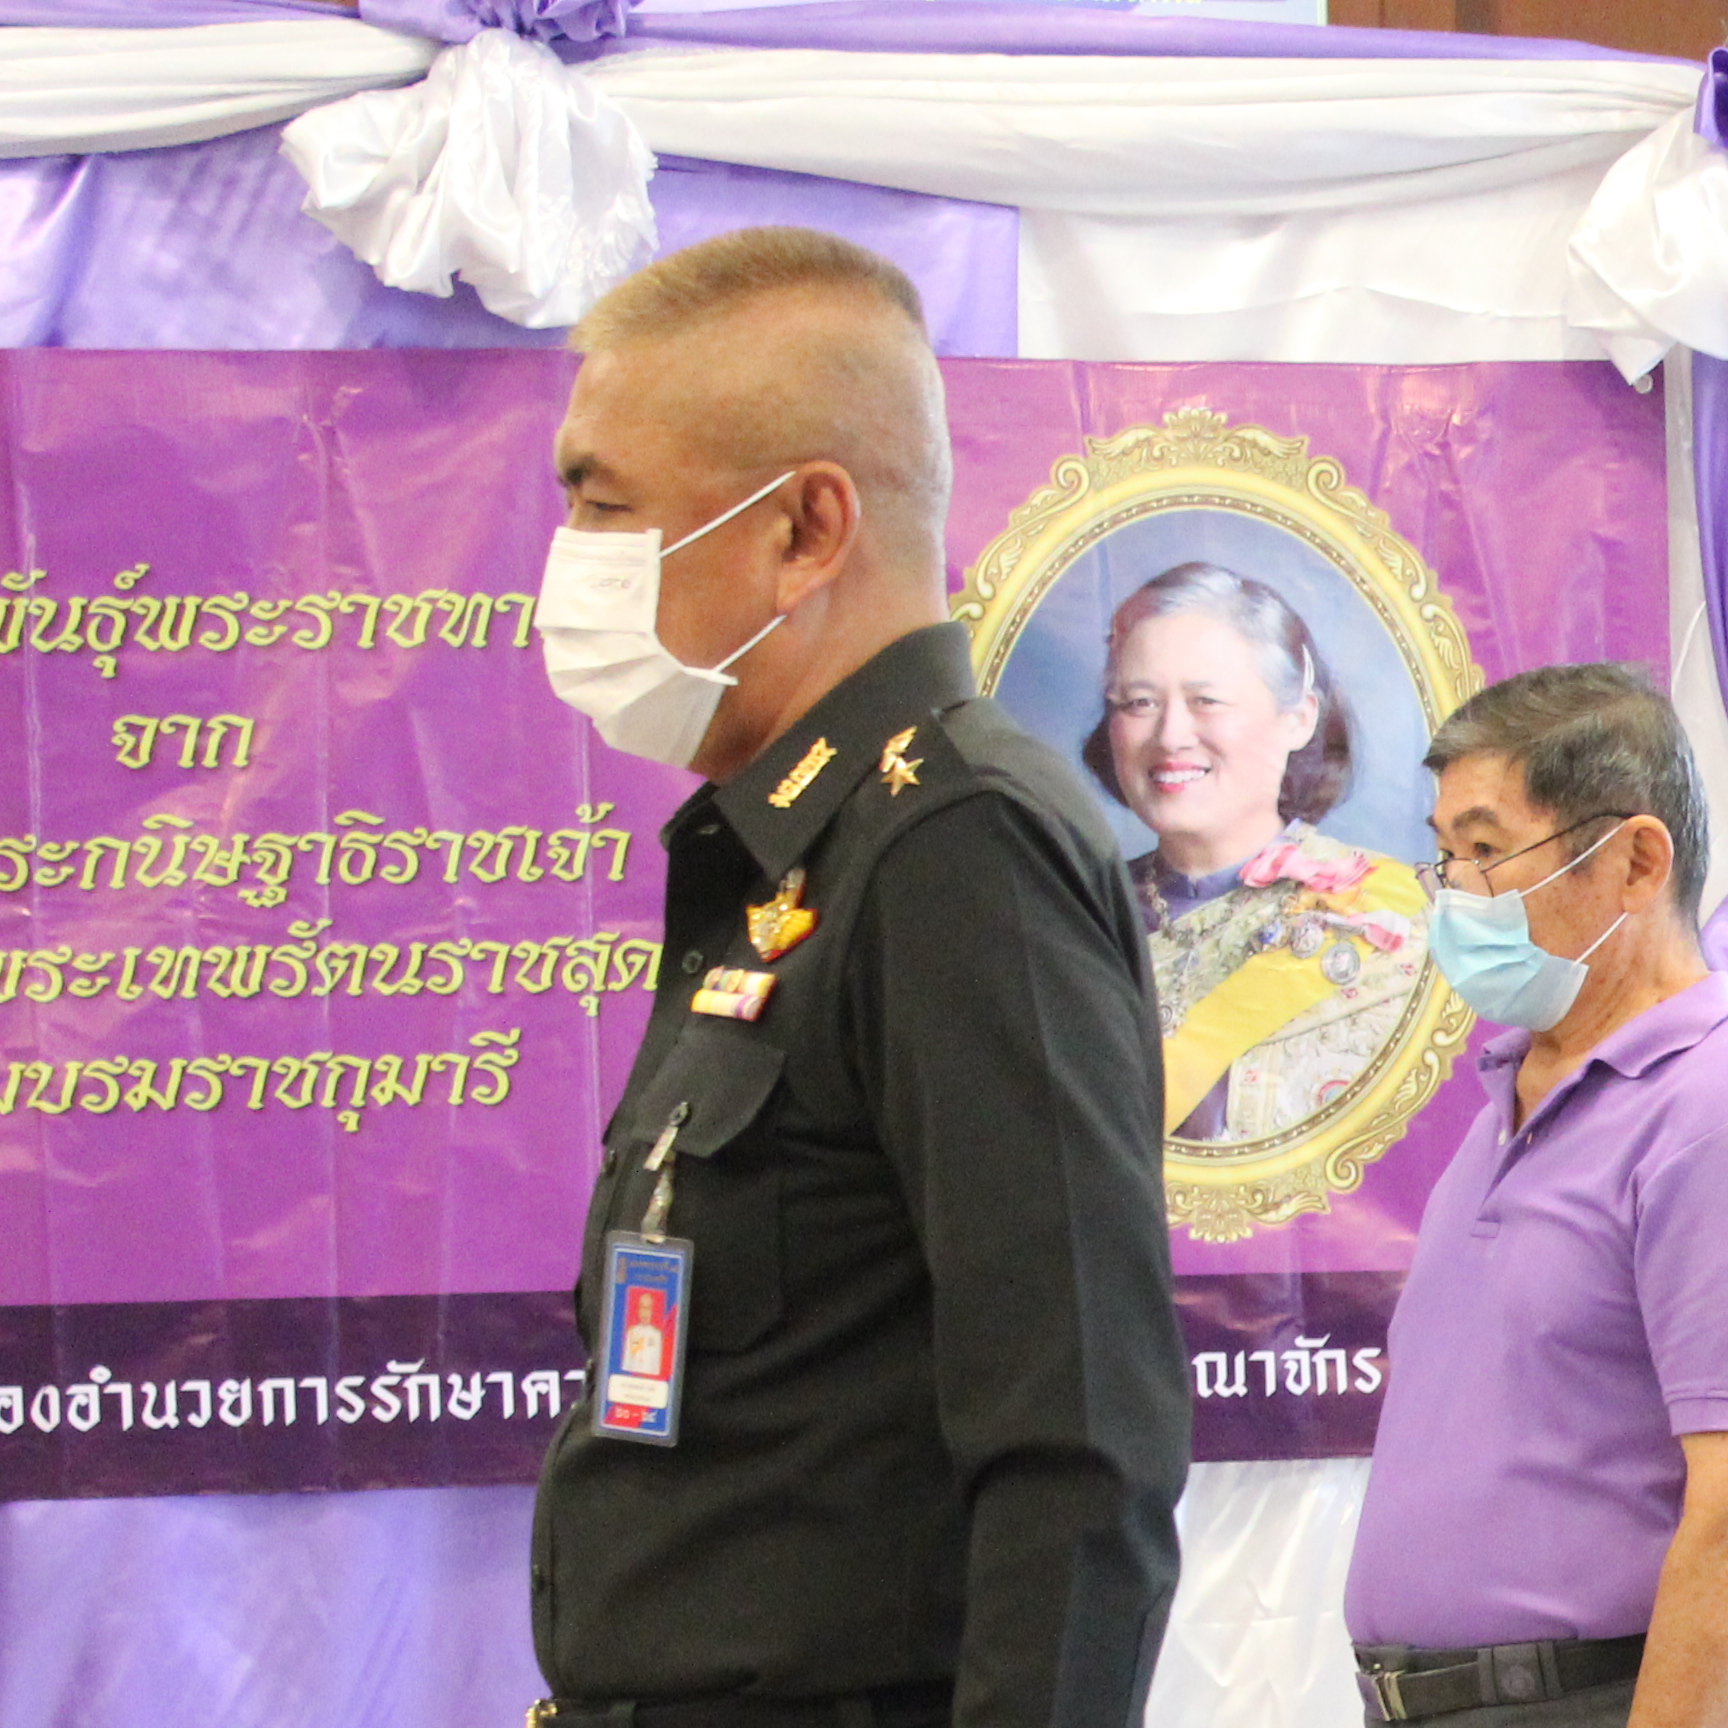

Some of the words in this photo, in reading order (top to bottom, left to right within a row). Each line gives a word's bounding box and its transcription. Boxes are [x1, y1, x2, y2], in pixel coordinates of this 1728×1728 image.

[112, 714, 254, 770] จาก
[1191, 1332, 1383, 1399] ณาจักร
